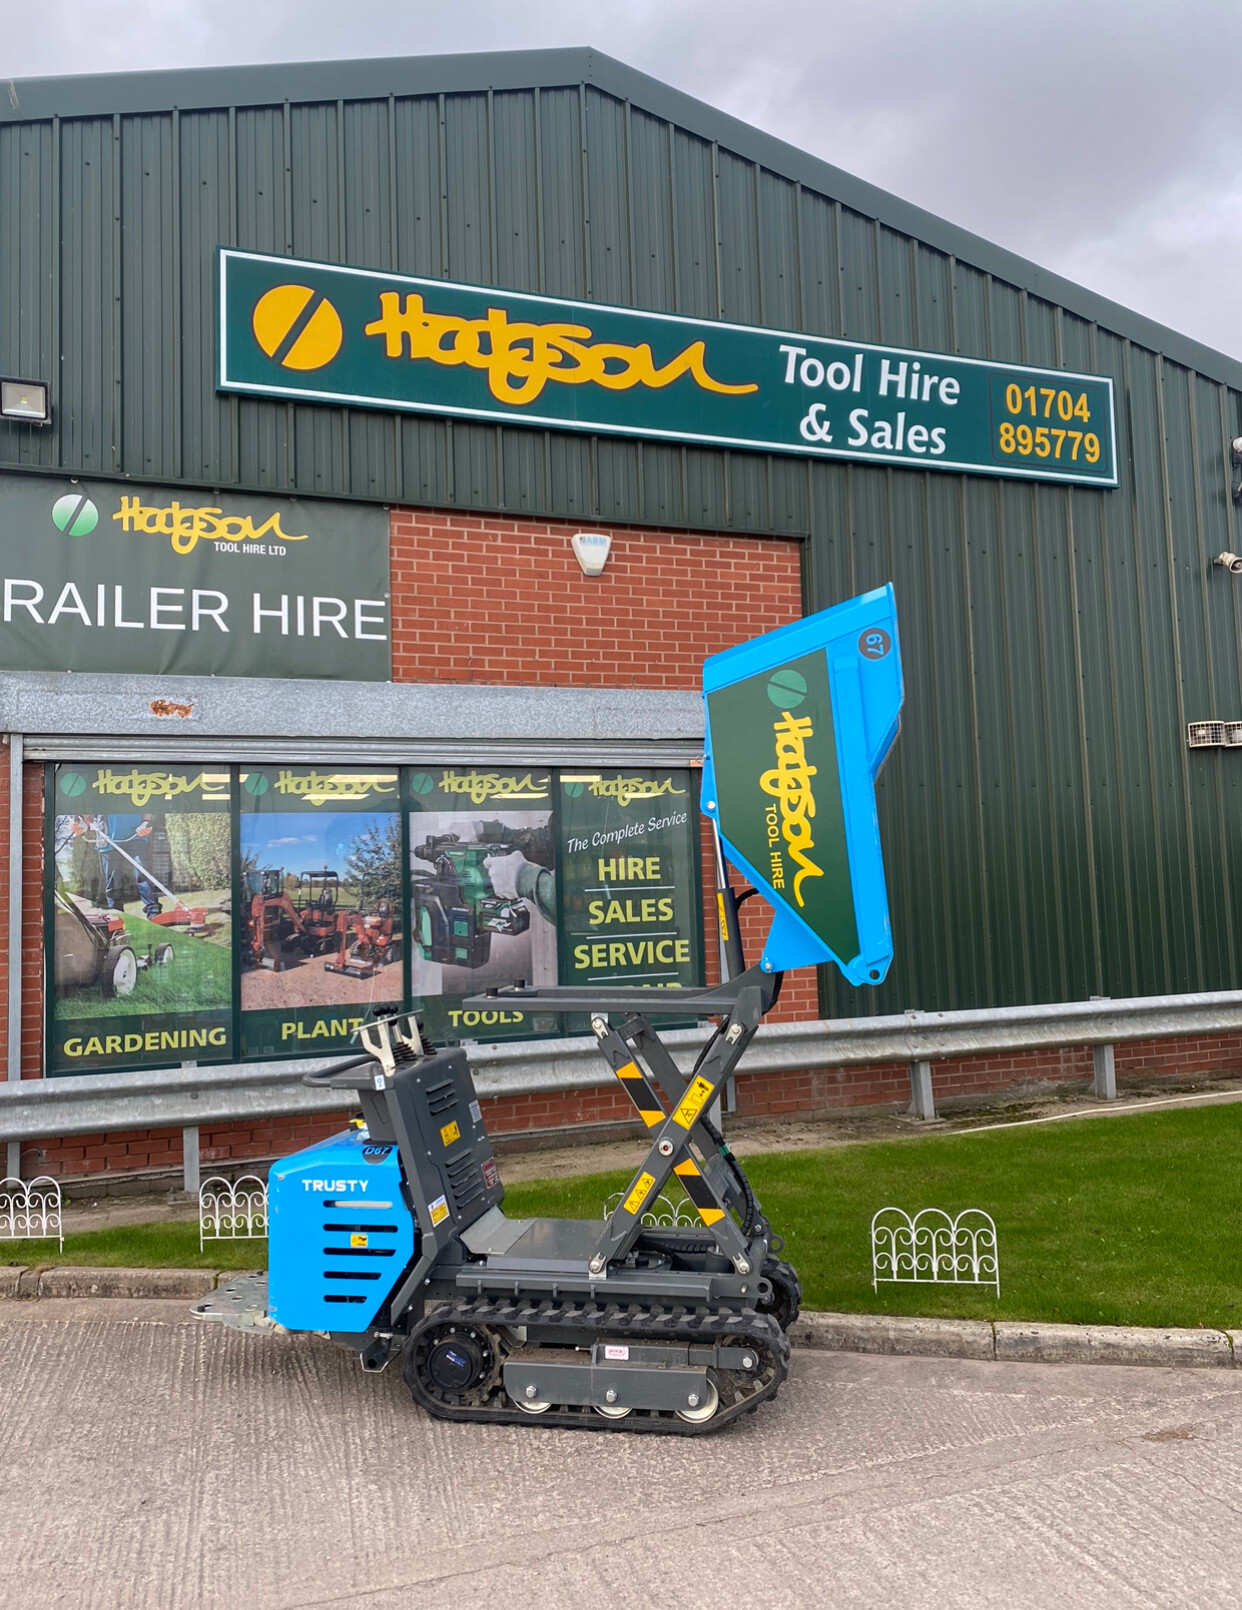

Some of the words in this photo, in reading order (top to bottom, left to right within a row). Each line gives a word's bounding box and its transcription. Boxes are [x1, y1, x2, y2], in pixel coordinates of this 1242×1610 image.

[364, 291, 759, 405] Hodgson
[779, 344, 864, 393] Tool
[878, 360, 960, 405] Hire
[1005, 382, 1091, 423] 01704
[799, 402, 833, 443] &
[847, 409, 946, 455] Sales
[999, 422, 1100, 464] 895779
[112, 495, 309, 555] Hodgson
[214, 541, 240, 554] TOOL
[243, 542, 266, 556] HIRE
[268, 543, 287, 556] LTD
[3, 578, 229, 633] RAILER
[253, 592, 388, 641] HIRE
[865, 633, 885, 655] 67
[92, 769, 226, 807] Hodgson
[274, 770, 396, 806] Hodgson
[438, 770, 547, 805] Hodgson
[588, 775, 686, 807] Hodgson
[759, 711, 824, 908] Hodgson
[765, 805, 780, 847] TOOL
[567, 837, 589, 853] The
[592, 822, 645, 847] Complete
[647, 811, 687, 832] Service
[598, 857, 661, 882] HIRE
[770, 849, 785, 889] HIRE
[589, 898, 674, 925] SALES
[574, 940, 690, 969] SERVICE
[281, 1018, 364, 1041] PLANT
[448, 1010, 524, 1027] TOOLS
[63, 1027, 227, 1057] GARDENING
[302, 1179, 369, 1192] TRUSTY
